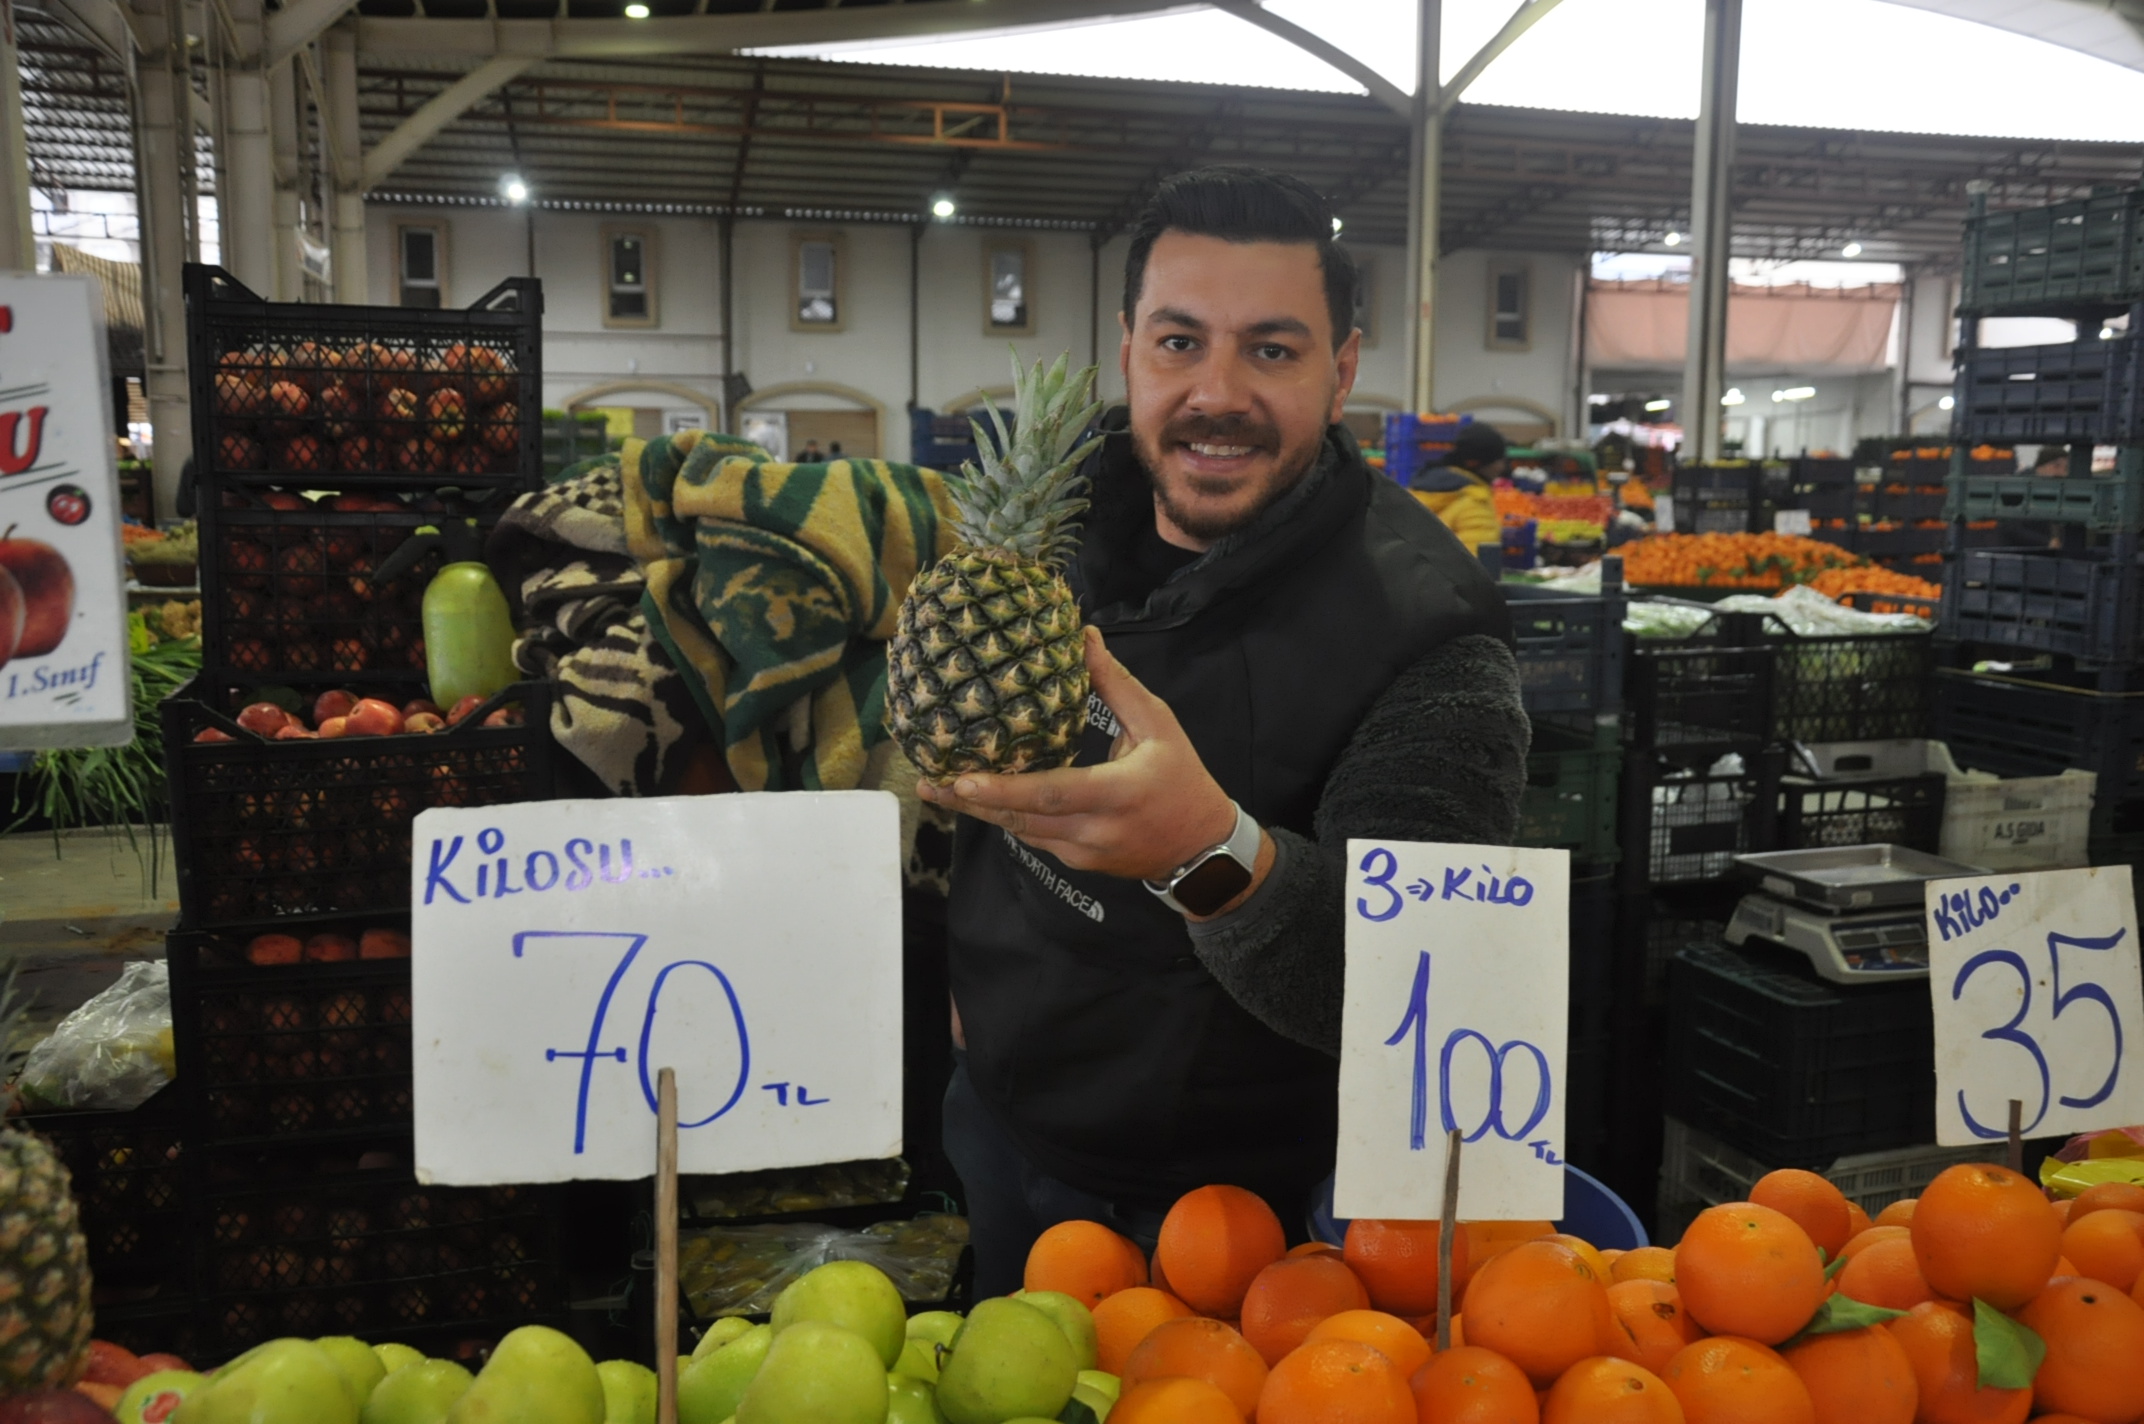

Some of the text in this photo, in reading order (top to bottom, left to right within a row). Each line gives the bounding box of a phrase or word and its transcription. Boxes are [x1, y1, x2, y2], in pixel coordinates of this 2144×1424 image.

[1019, 846, 1057, 890] NORTH
[1054, 878, 1093, 914] FACE
[1357, 847, 1403, 922] 3
[512, 931, 830, 1154] 70 TL
[1384, 950, 1551, 1150] 100
[1953, 926, 2127, 1140] 35
[1528, 1140, 1563, 1165] TL
